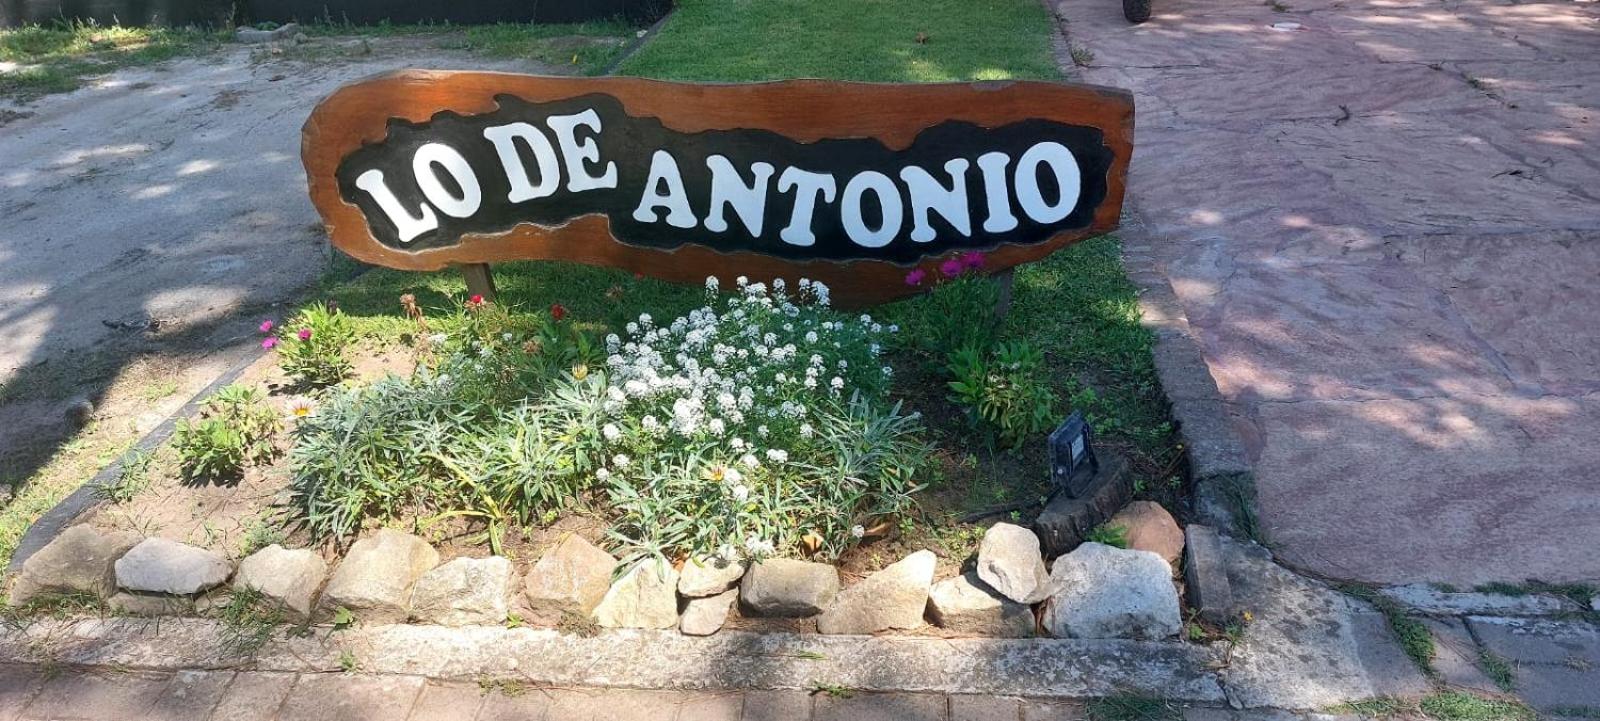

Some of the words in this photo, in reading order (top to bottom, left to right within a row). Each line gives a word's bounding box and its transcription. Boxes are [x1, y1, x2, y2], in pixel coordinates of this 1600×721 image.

[355, 142, 482, 243] LO
[483, 108, 618, 204] DE
[632, 141, 1081, 248] ANTONIO
